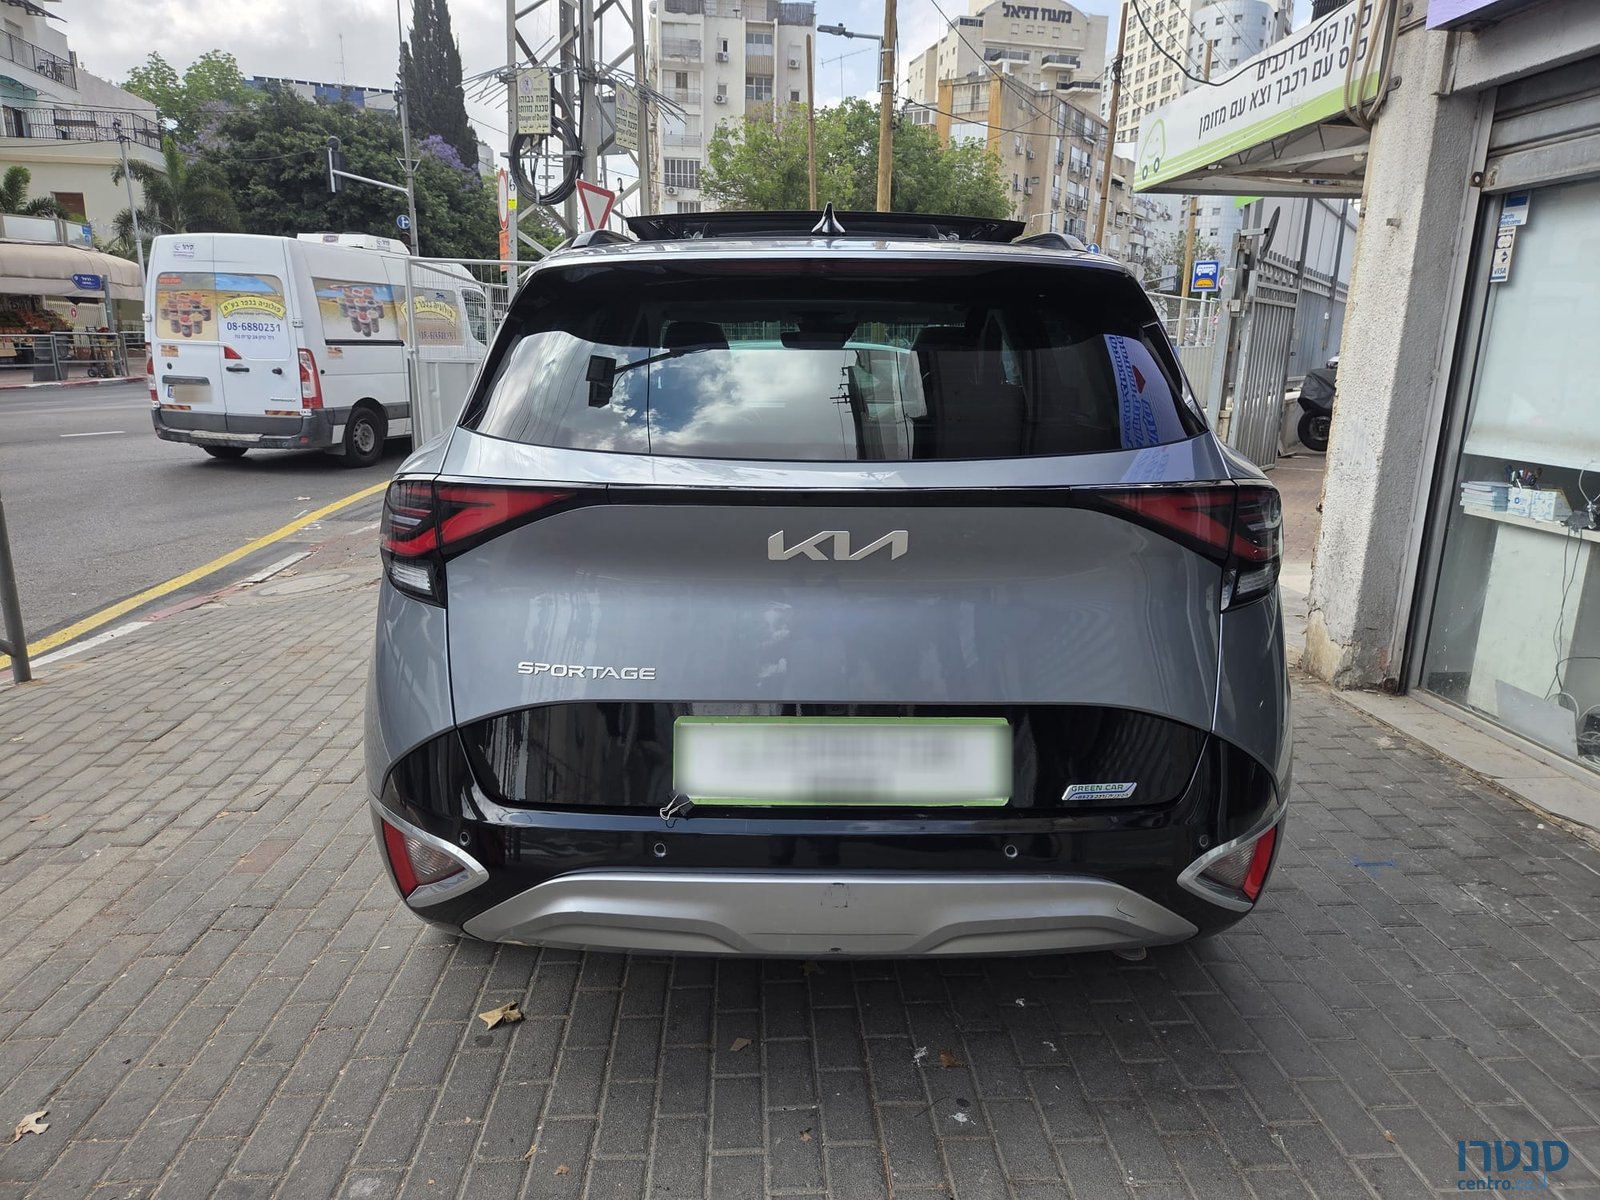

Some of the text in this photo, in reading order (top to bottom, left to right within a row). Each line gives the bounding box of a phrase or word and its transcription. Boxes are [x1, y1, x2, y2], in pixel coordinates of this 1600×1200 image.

[1002, 1, 1072, 24] מעוז דניאל
[1299, 22, 1338, 58] קונים
[1257, 48, 1296, 82] רכבים
[1198, 37, 1368, 140] כס עם רכבך וצא עם מזומן
[226, 321, 281, 333] 08-6880231
[767, 529, 909, 561] KIA
[517, 661, 657, 681] SPORTAGE
[1071, 784, 1103, 792] GREEN
